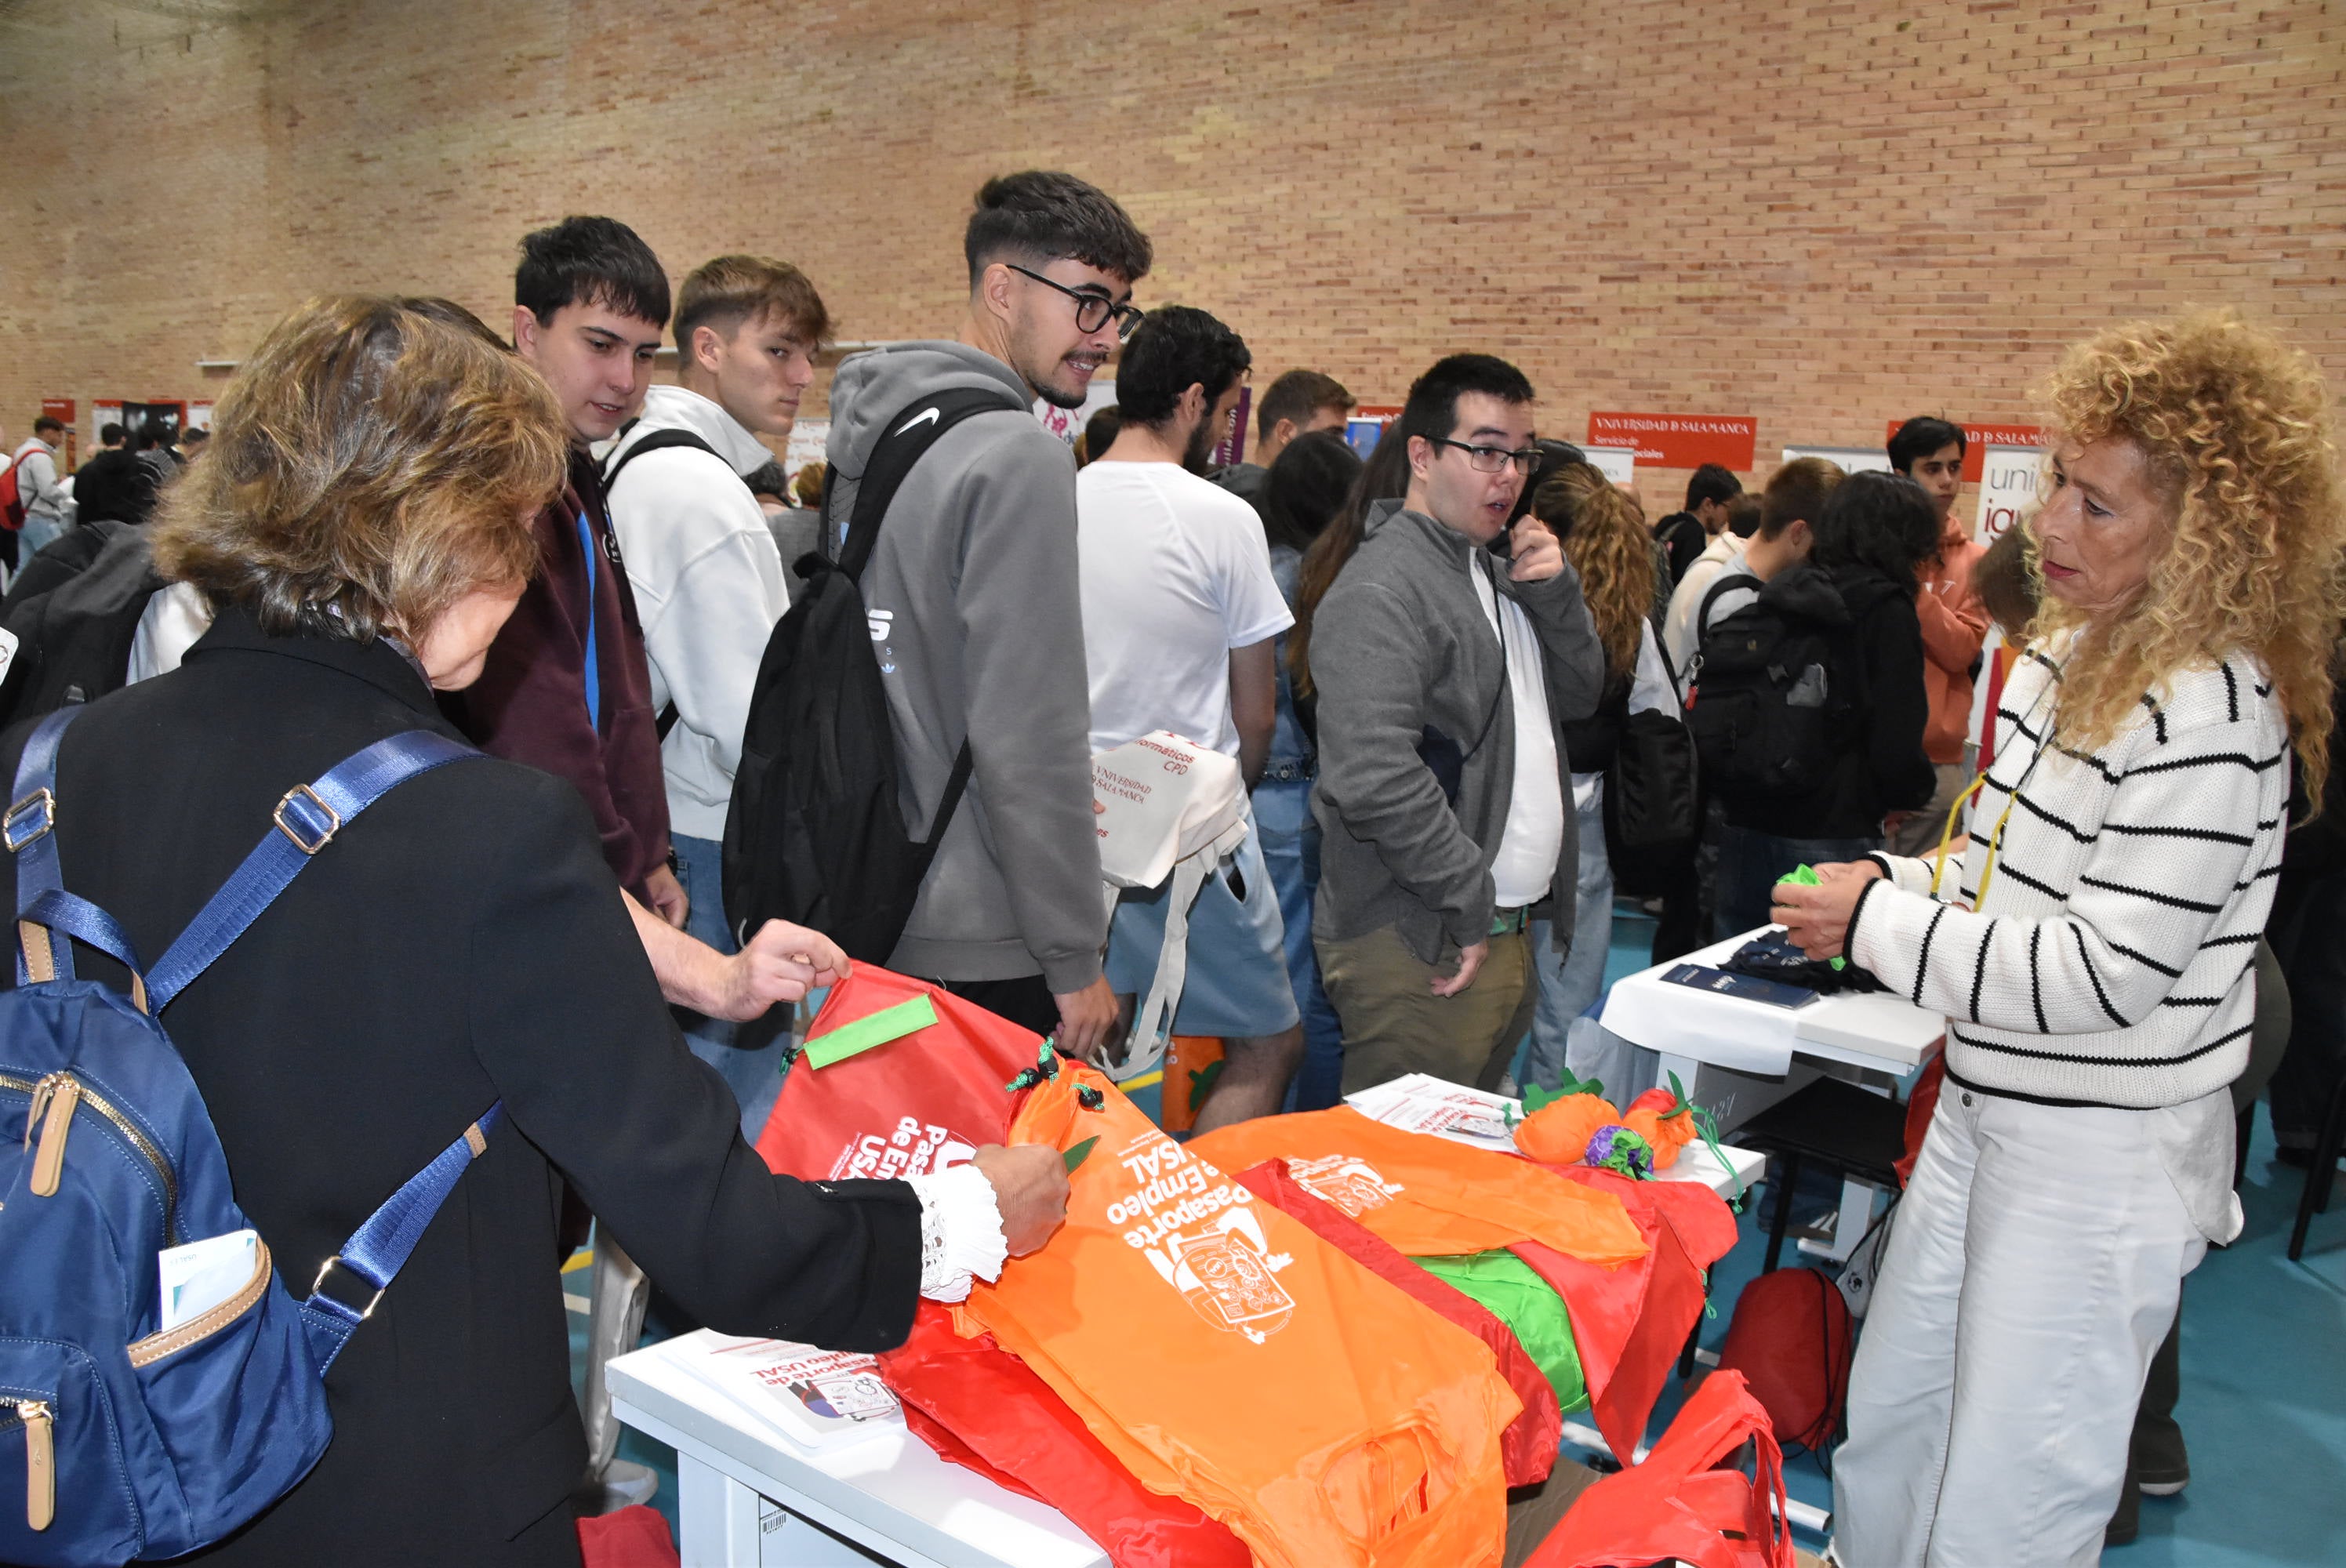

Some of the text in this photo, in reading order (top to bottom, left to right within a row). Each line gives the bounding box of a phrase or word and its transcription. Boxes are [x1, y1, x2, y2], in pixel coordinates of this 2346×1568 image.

[1680, 421, 1749, 434] SALAMANCA
[1594, 435, 1640, 447] Servicio de
[1634, 448, 1665, 459] ociales
[1991, 463, 2036, 492] uni
[1164, 760, 1189, 775] CPD
[892, 1116, 921, 1146] de
[1106, 1165, 1208, 1225] Empleo
[1124, 1182, 1255, 1248] Pasaporte
[753, 1362, 808, 1378] USAL
[765, 1356, 871, 1386] asaporte de
